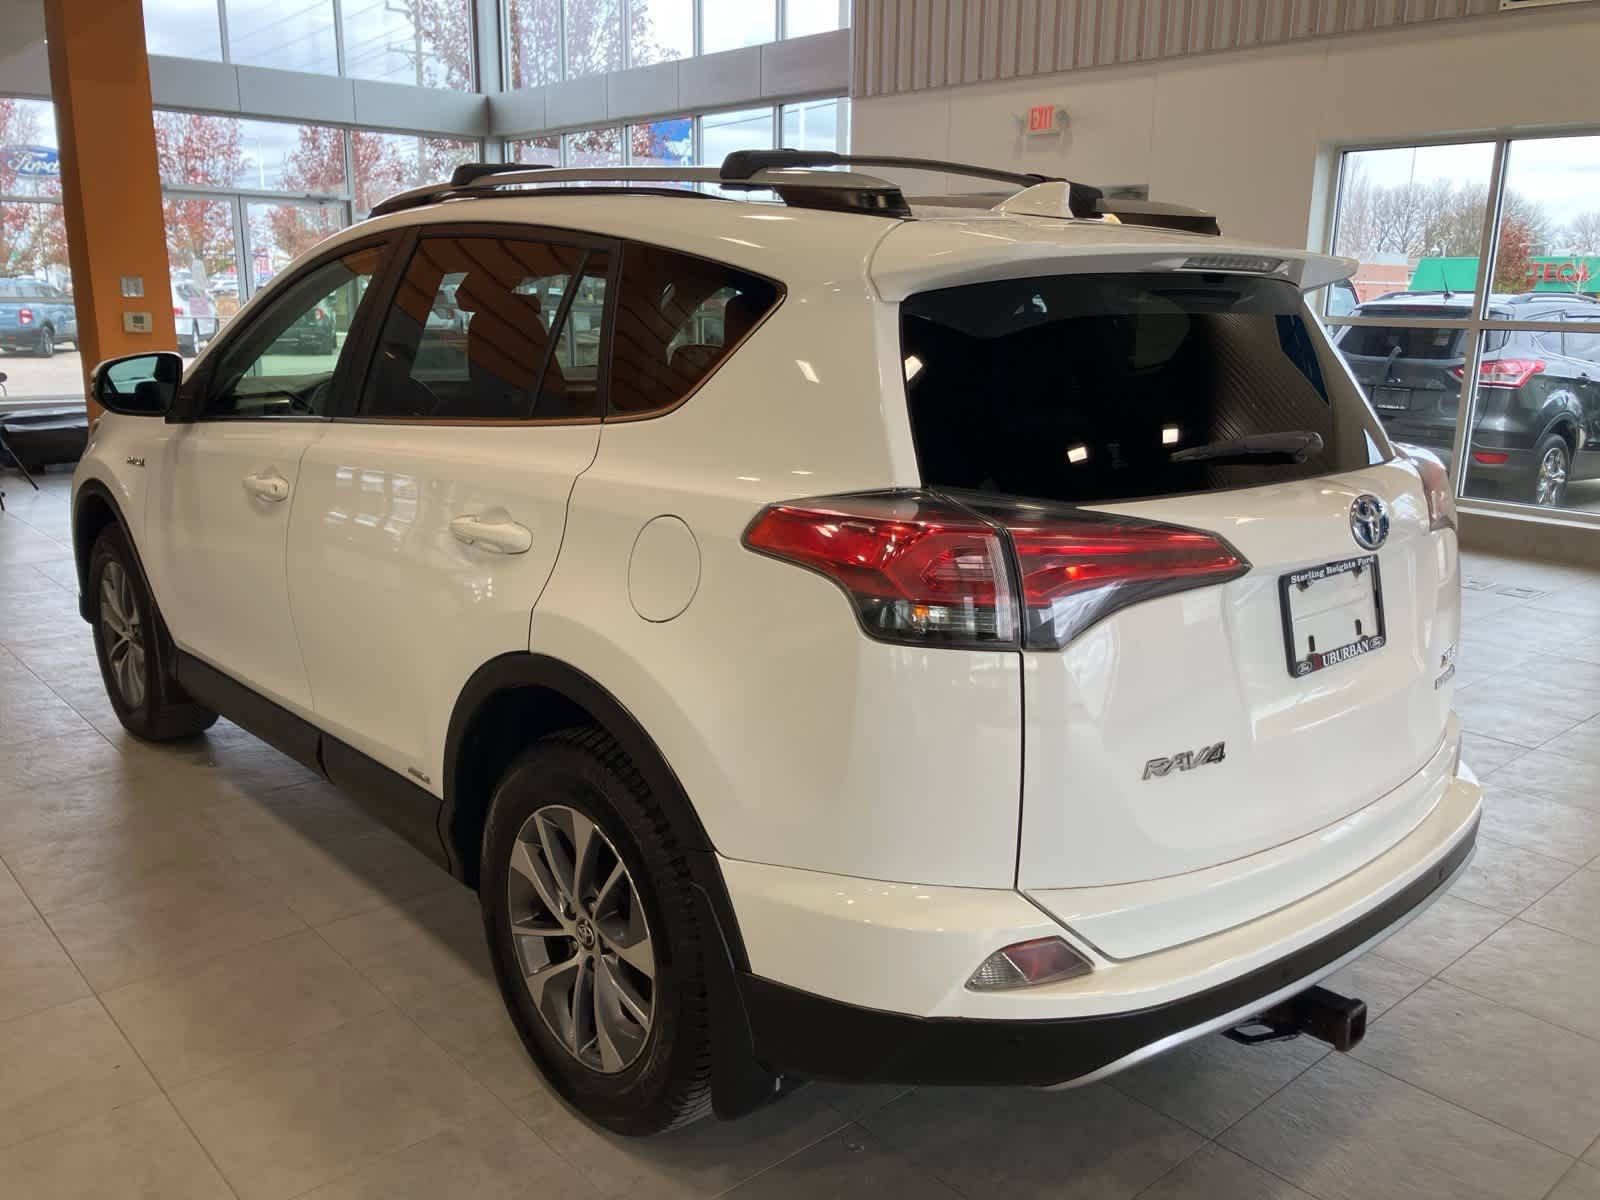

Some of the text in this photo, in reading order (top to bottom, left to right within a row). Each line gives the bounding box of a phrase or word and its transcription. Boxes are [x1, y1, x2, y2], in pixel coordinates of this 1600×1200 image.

[1030, 104, 1055, 130] EXIT
[1291, 569, 1325, 584] Sterling
[1326, 560, 1356, 574] Heights
[1312, 640, 1369, 671] UBURBAN
[1141, 741, 1226, 780] RAV4
